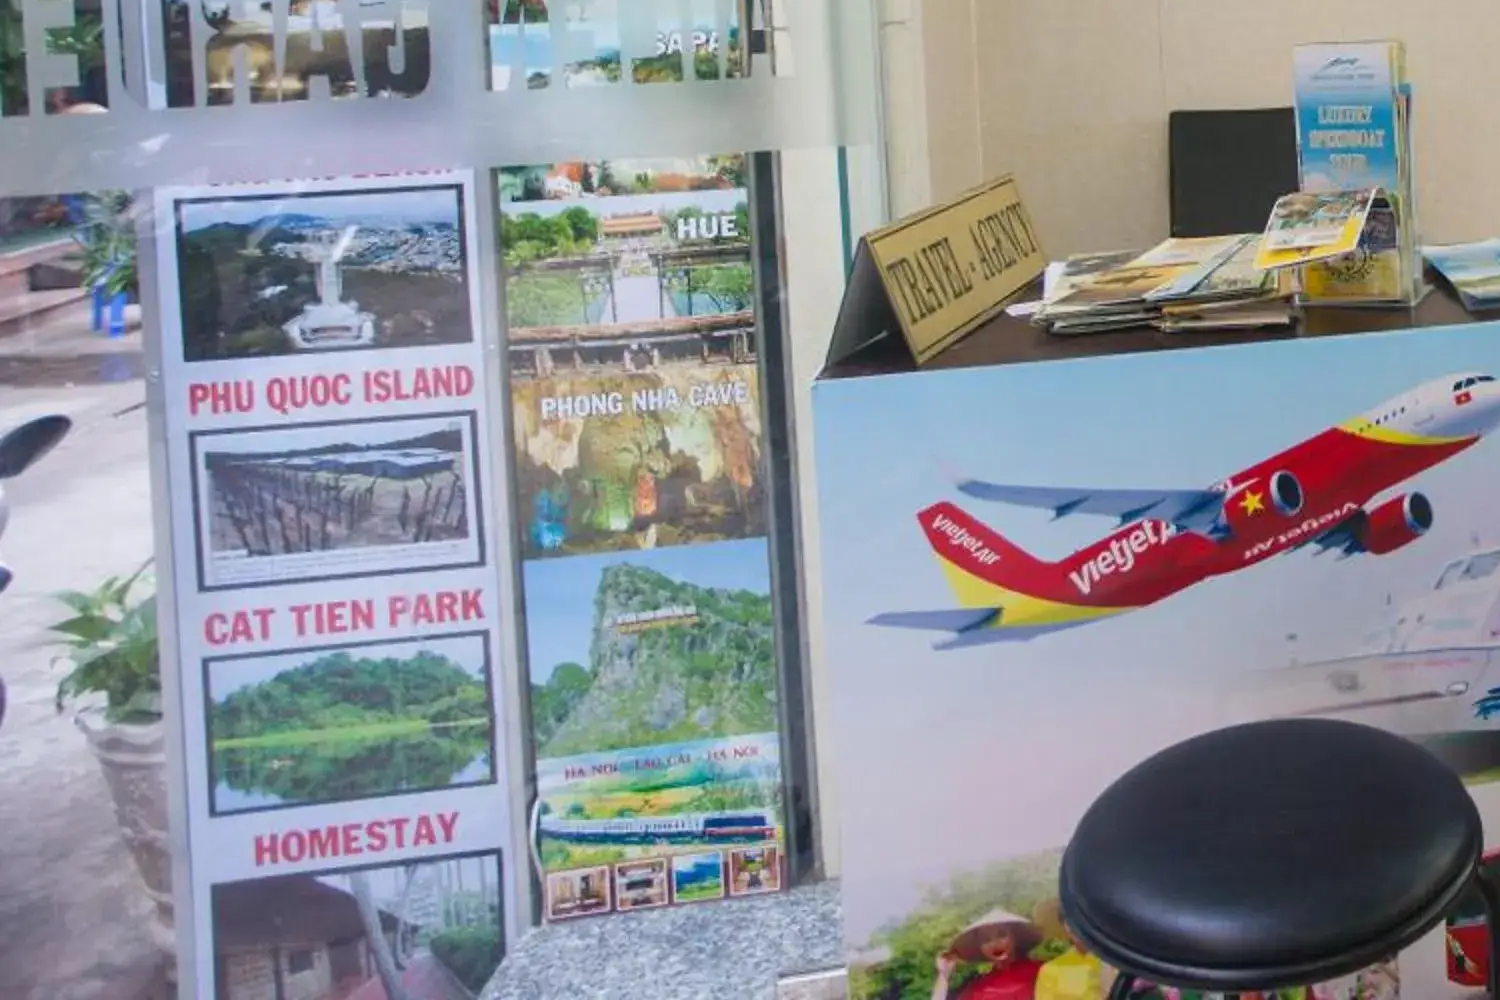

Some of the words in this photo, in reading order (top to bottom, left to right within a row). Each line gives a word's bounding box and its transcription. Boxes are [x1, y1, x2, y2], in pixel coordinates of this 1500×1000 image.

[677, 214, 739, 241] HUE
[885, 236, 974, 326] TRAVEL
[968, 201, 1038, 281] AGENCY
[188, 381, 255, 416] PHU
[266, 372, 351, 416] QUOC
[363, 364, 474, 403] ISLAND
[541, 391, 624, 421] PHONG
[631, 386, 680, 414] NHA
[690, 381, 749, 408] CAVE
[204, 608, 275, 646] CAT
[289, 599, 376, 638] TIEN
[388, 588, 486, 628] PARK
[254, 812, 460, 867] HOMESTAY
